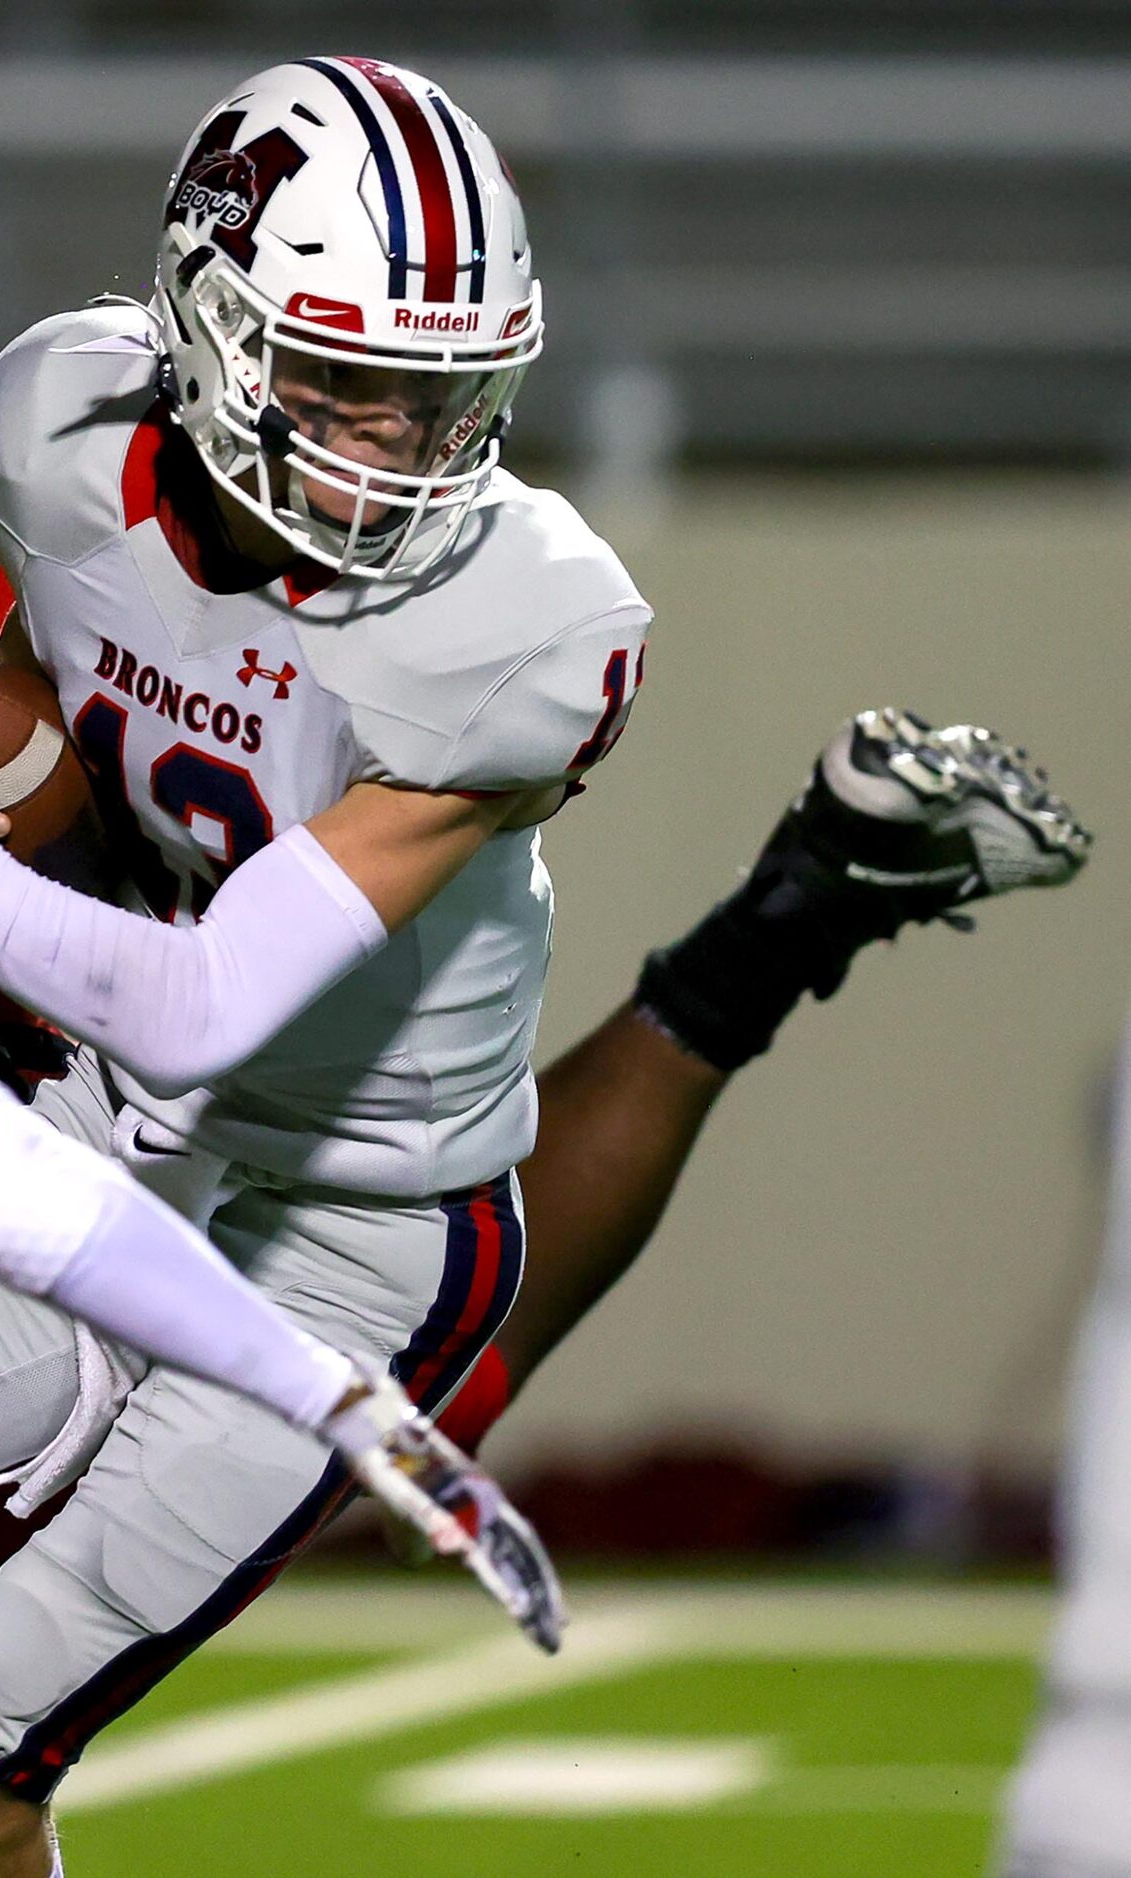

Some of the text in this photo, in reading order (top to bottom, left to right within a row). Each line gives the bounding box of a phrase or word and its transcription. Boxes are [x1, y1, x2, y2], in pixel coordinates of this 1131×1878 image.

[177, 181, 250, 230] BOYD
[394, 307, 480, 332] Riddell
[93, 637, 263, 755] BRONCOS
